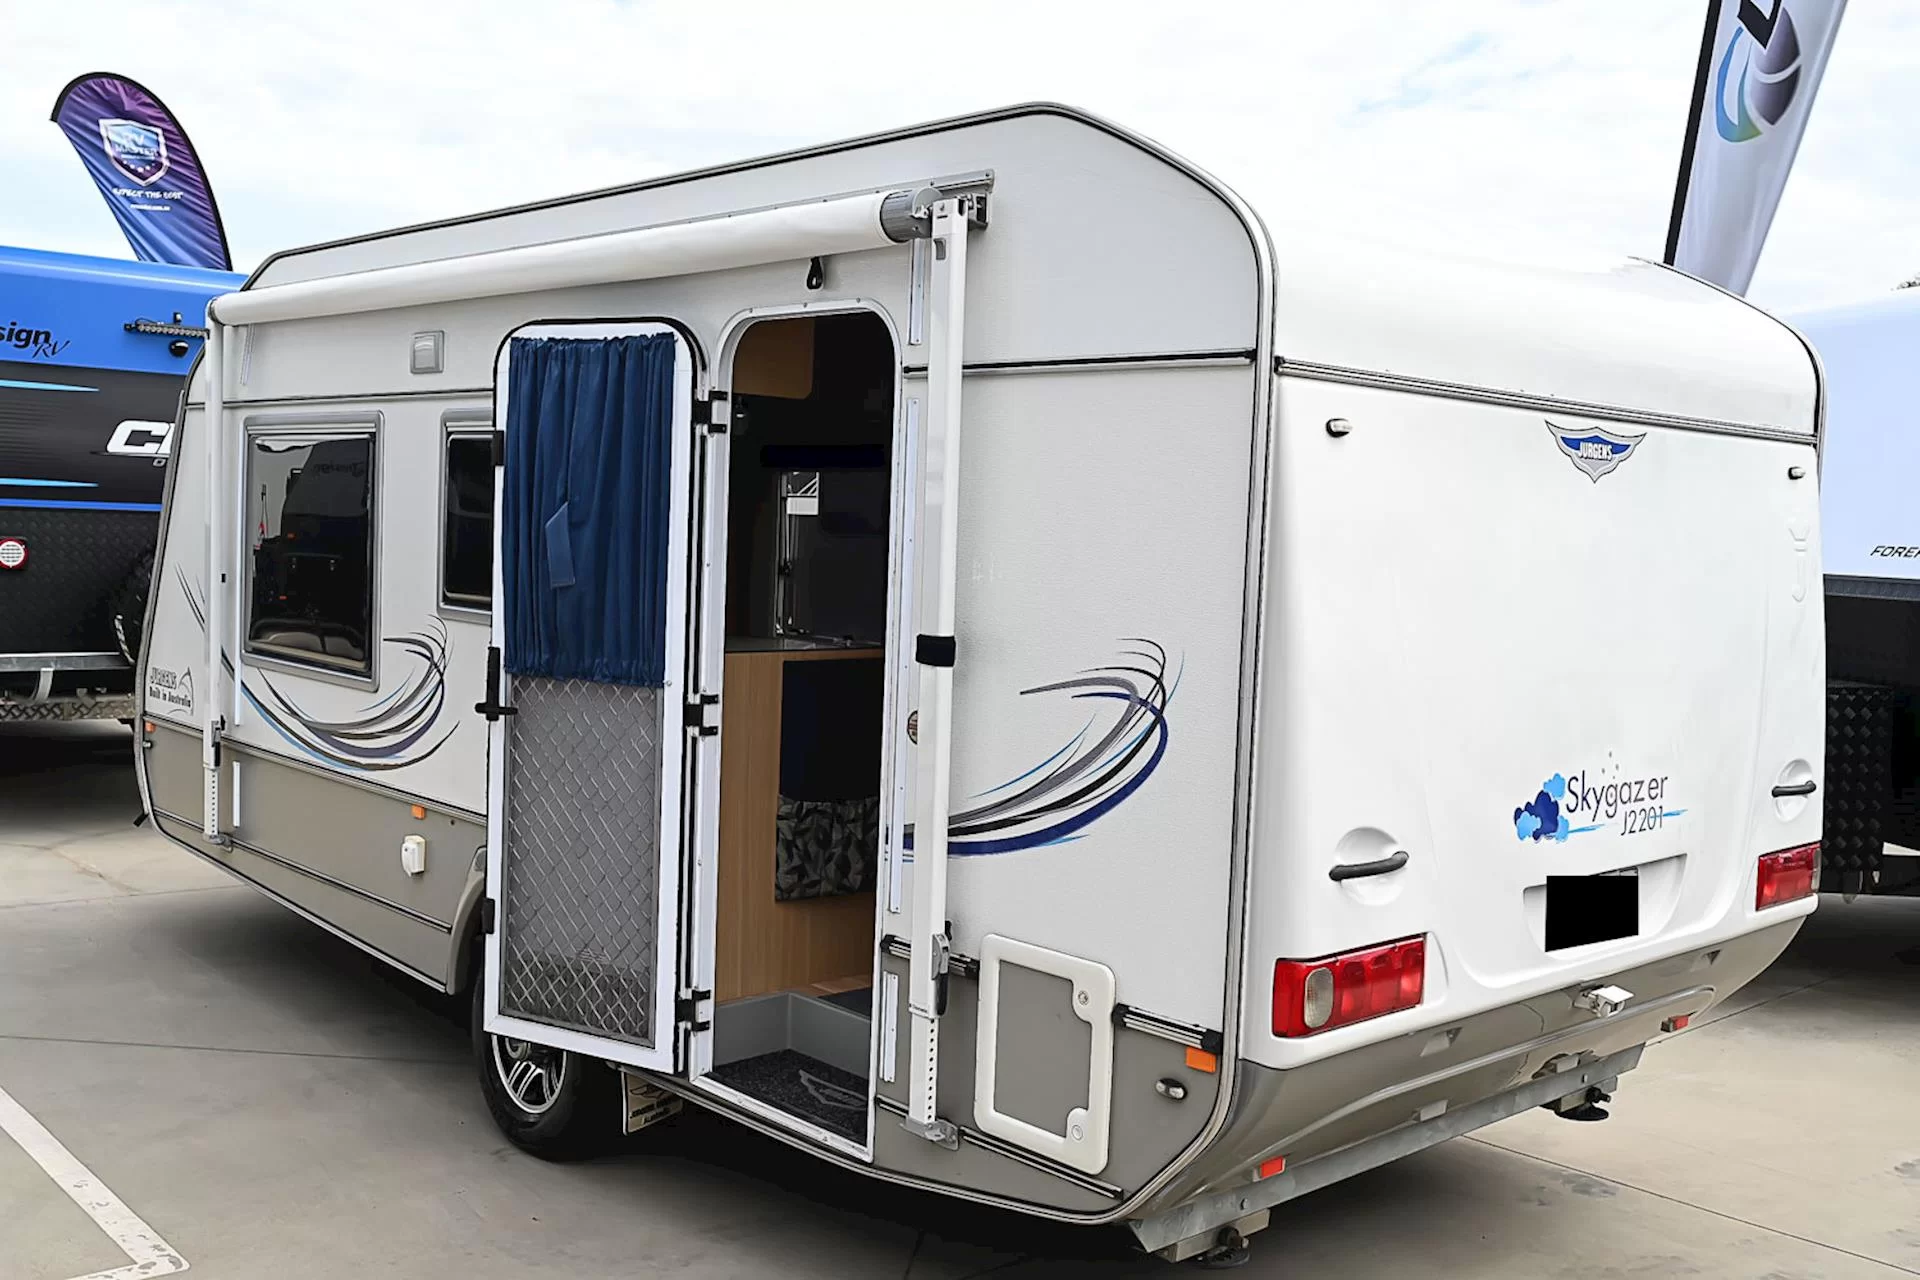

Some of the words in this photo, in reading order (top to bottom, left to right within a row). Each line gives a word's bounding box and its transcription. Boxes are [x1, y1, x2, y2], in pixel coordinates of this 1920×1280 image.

[1579, 440, 1613, 461] JURGENS
[1566, 769, 1668, 822] Skygazer
[1620, 805, 1663, 836] J2201
